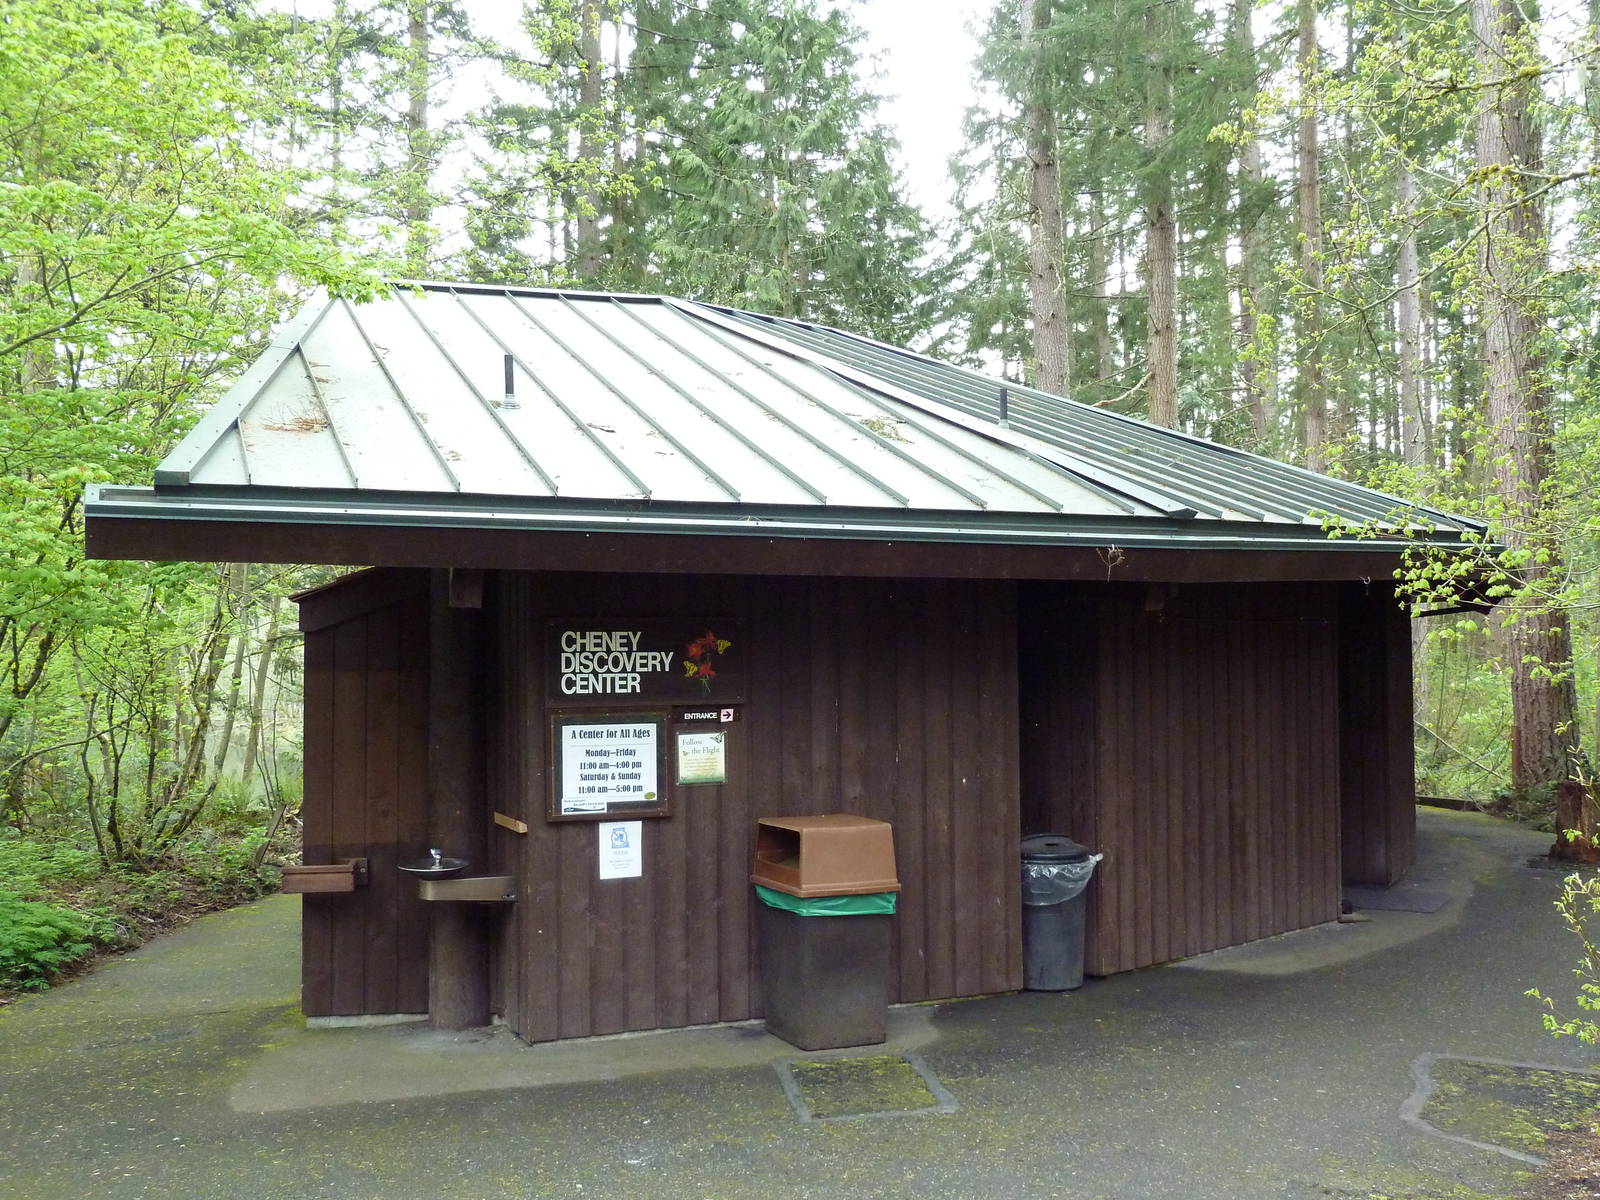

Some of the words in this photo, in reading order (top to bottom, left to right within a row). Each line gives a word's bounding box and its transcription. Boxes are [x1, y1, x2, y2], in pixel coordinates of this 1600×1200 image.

[561, 631, 641, 652] CHENEY
[561, 652, 674, 673] DISCOVERY
[561, 673, 640, 694] CENTER
[684, 712, 718, 720] ENTRANCE
[571, 730, 577, 739] A
[579, 729, 604, 739] Center
[606, 729, 618, 738] for
[620, 729, 630, 738] All
[633, 728, 651, 739] Ages
[702, 747, 720, 756] Flight
[579, 762, 597, 770] 11:00
[631, 761, 642, 770] pm
[579, 773, 609, 782] Saturday
[617, 772, 642, 781] Sunday
[578, 786, 596, 794] 11:00
[632, 784, 643, 793] pm
